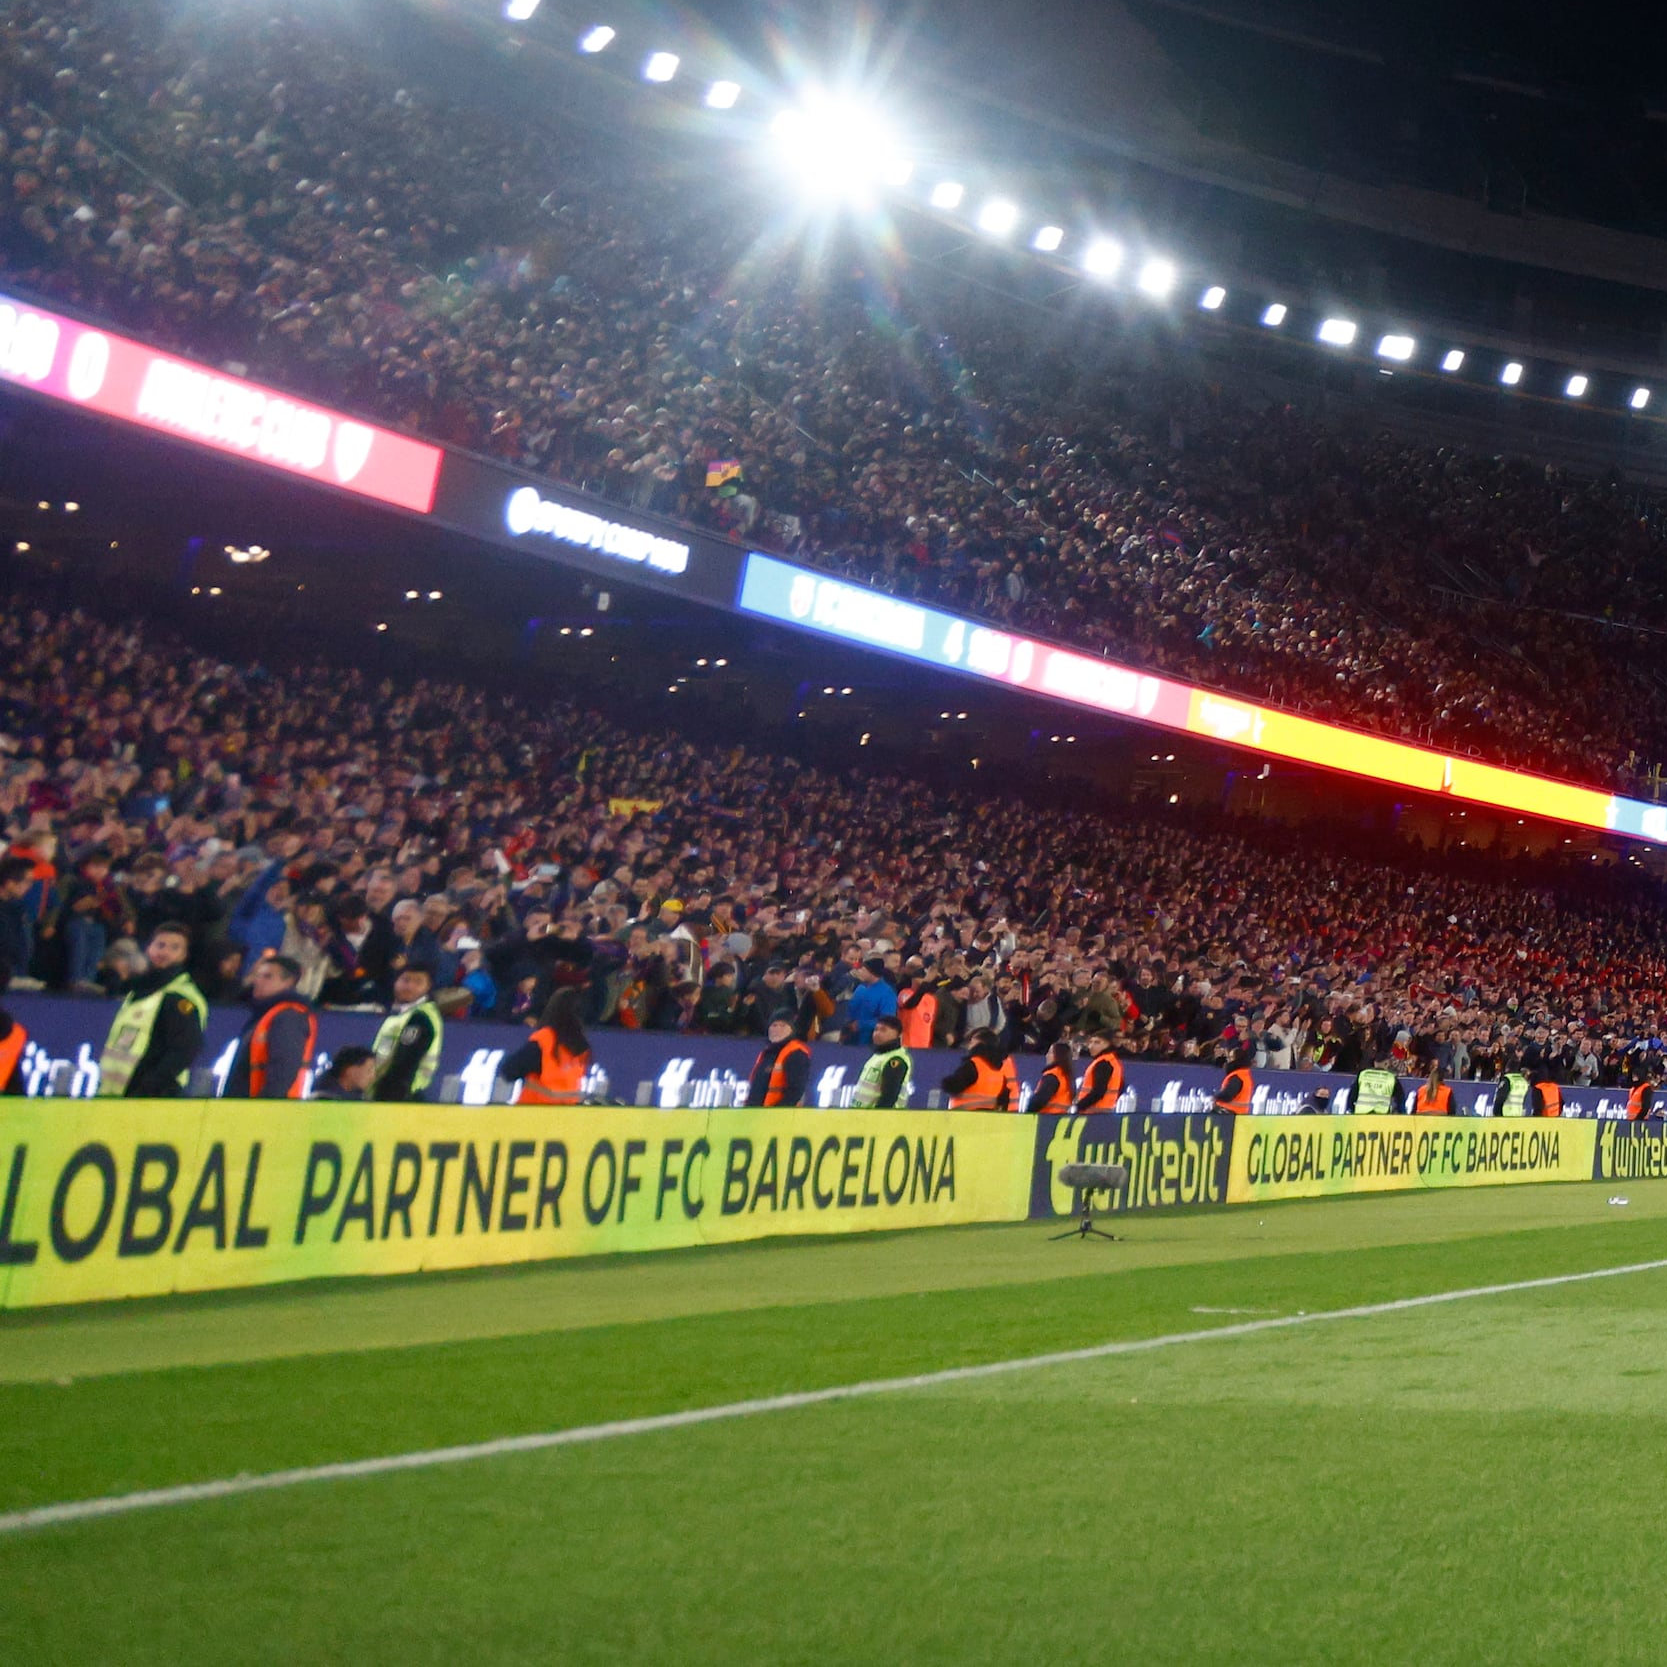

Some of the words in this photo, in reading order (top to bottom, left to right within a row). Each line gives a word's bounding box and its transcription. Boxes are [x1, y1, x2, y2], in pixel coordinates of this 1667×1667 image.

[294, 1140, 568, 1245] PARTNER
[582, 1137, 647, 1226] OF
[654, 1135, 711, 1221] FC
[720, 1135, 956, 1216] BARCELONA
[1081, 1116, 1223, 1211] whitebit
[1248, 1132, 1326, 1184] GLOBAL
[1331, 1131, 1413, 1179] PARTNER
[1417, 1131, 1440, 1174] OF
[1441, 1131, 1464, 1174] FC
[1465, 1131, 1561, 1173] BARCELONA
